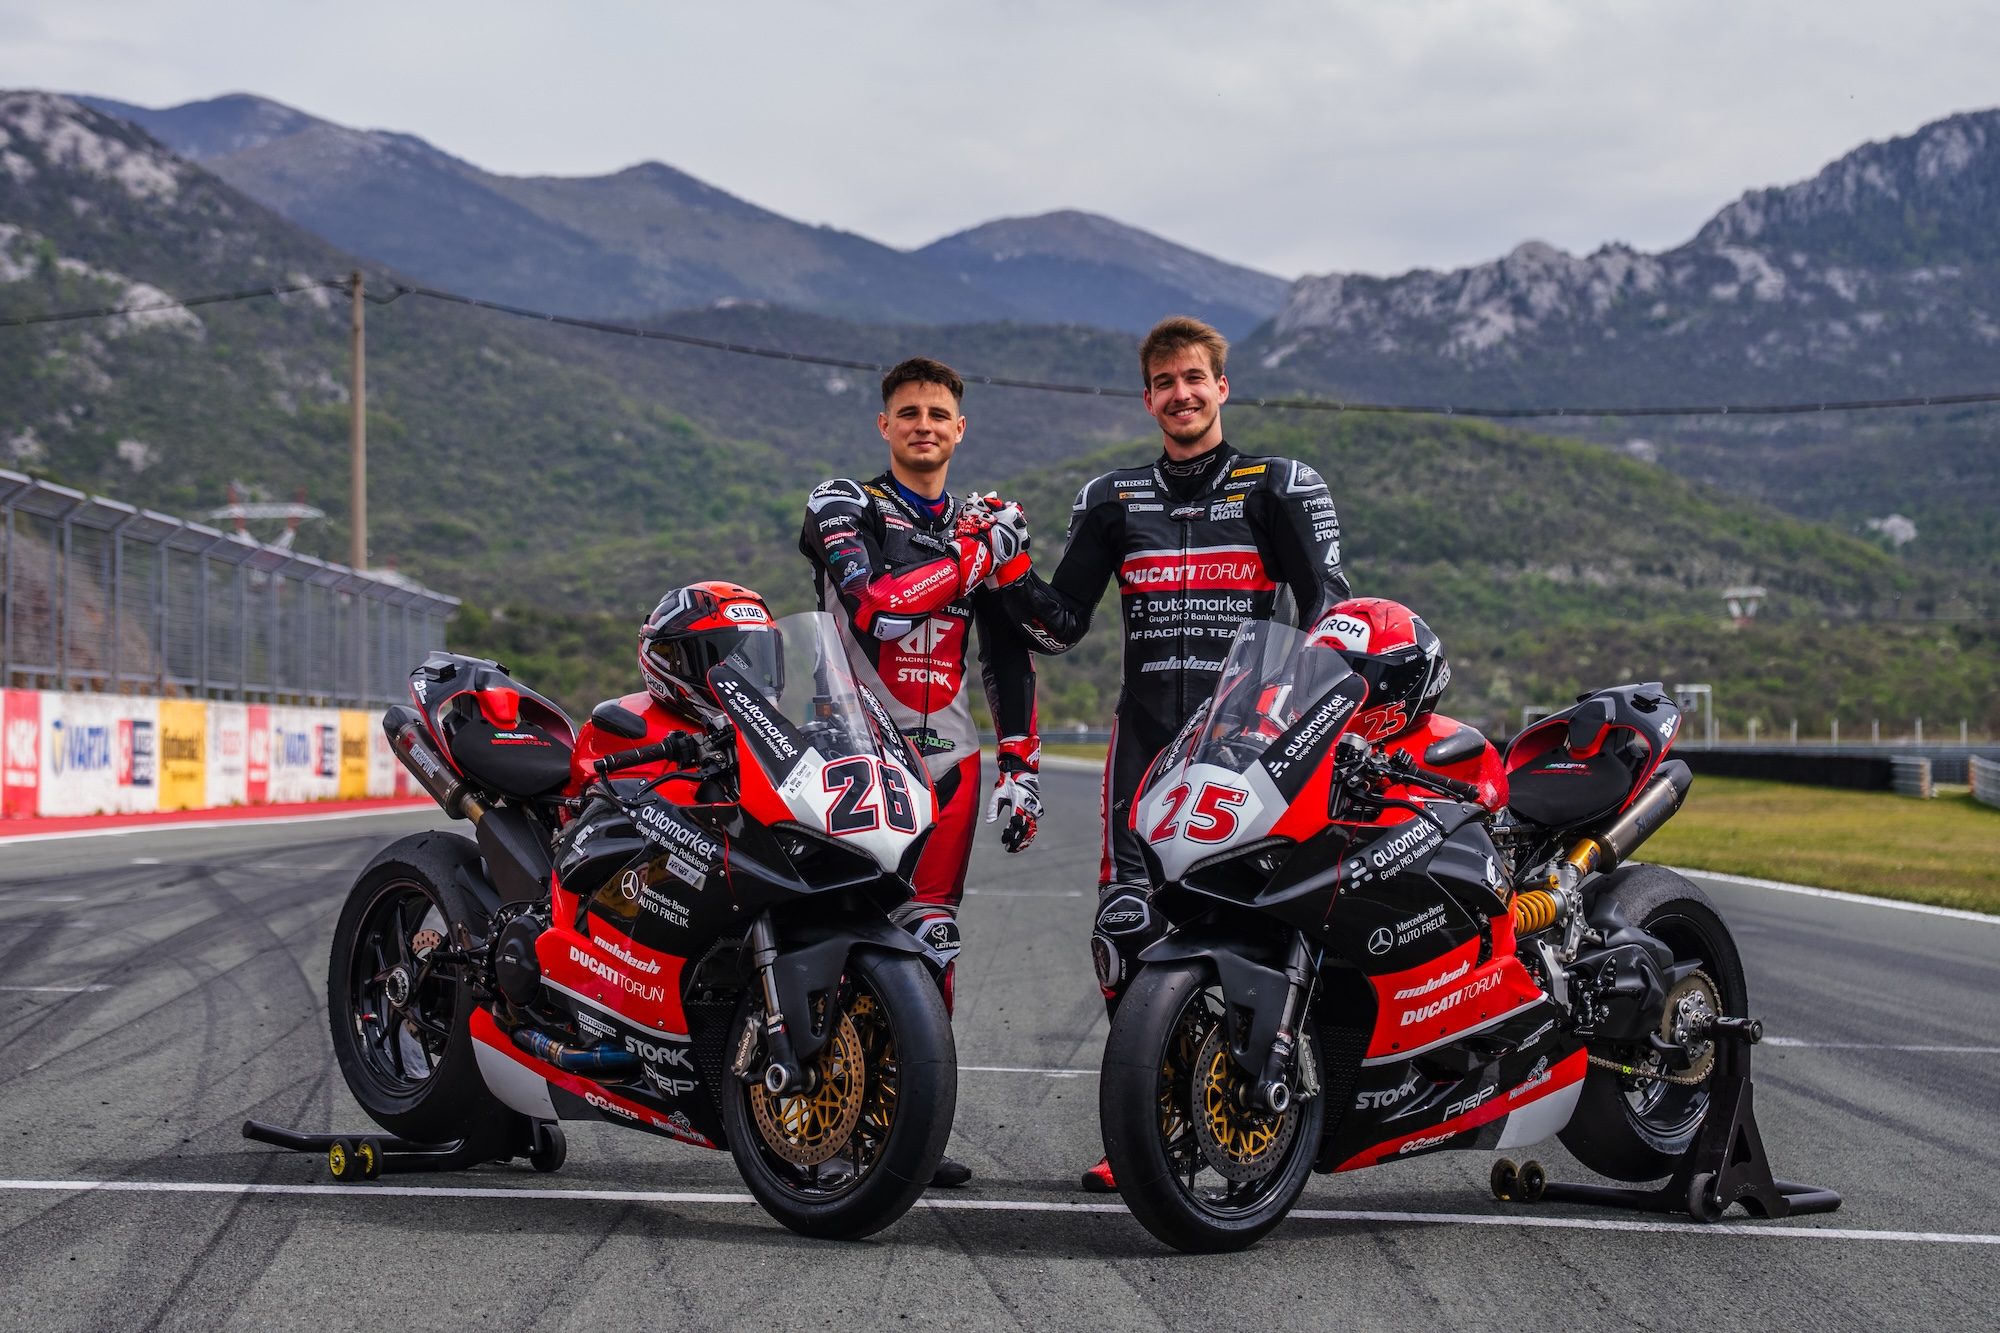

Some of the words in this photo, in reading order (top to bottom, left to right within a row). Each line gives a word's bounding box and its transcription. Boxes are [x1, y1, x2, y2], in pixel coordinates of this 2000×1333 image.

[1211, 510, 1244, 521] MOTO
[903, 564, 954, 598] automarket
[1124, 565, 1197, 584] DUCATI
[1198, 562, 1256, 580] TORUŃ
[731, 607, 764, 618] SHOEI
[946, 606, 970, 617] TEAM
[1147, 596, 1254, 612] automarket
[1149, 614, 1170, 624] Grupa
[1191, 612, 1215, 621] Banku
[1130, 631, 1142, 640] AF
[1144, 627, 1204, 639] RACING
[898, 668, 953, 691] STORK
[932, 660, 953, 668] TEAM
[736, 692, 798, 757] automarket
[1284, 694, 1348, 757] automarket
[1364, 700, 1408, 744] 25
[822, 756, 917, 836] 26
[1149, 781, 1248, 846] 25
[642, 806, 718, 861] automarket
[1373, 812, 1444, 869] automarkt
[659, 836, 678, 854] Banku
[678, 845, 709, 872] Polskiego
[1380, 864, 1401, 882] Grupa
[1400, 855, 1414, 870] PKO
[1412, 846, 1430, 862] Banku
[638, 895, 659, 914] AUTO
[659, 908, 690, 928] FRELIK
[641, 882, 690, 916] Mercedes-Benz
[1101, 911, 1145, 925] RST
[1396, 903, 1445, 934] Mercedes-Benz
[1397, 929, 1421, 947] AUTO
[1421, 914, 1448, 939] FRELIK
[570, 946, 618, 985] DUCATI
[594, 935, 661, 975] mototech
[1394, 960, 1470, 1000] mototech
[1400, 991, 1463, 1026] DUCATI
[625, 1035, 694, 1072] STORK
[736, 1032, 751, 1066] brembo
[1304, 1051, 1315, 1086] brembo
[1355, 1076, 1418, 1110] STORK
